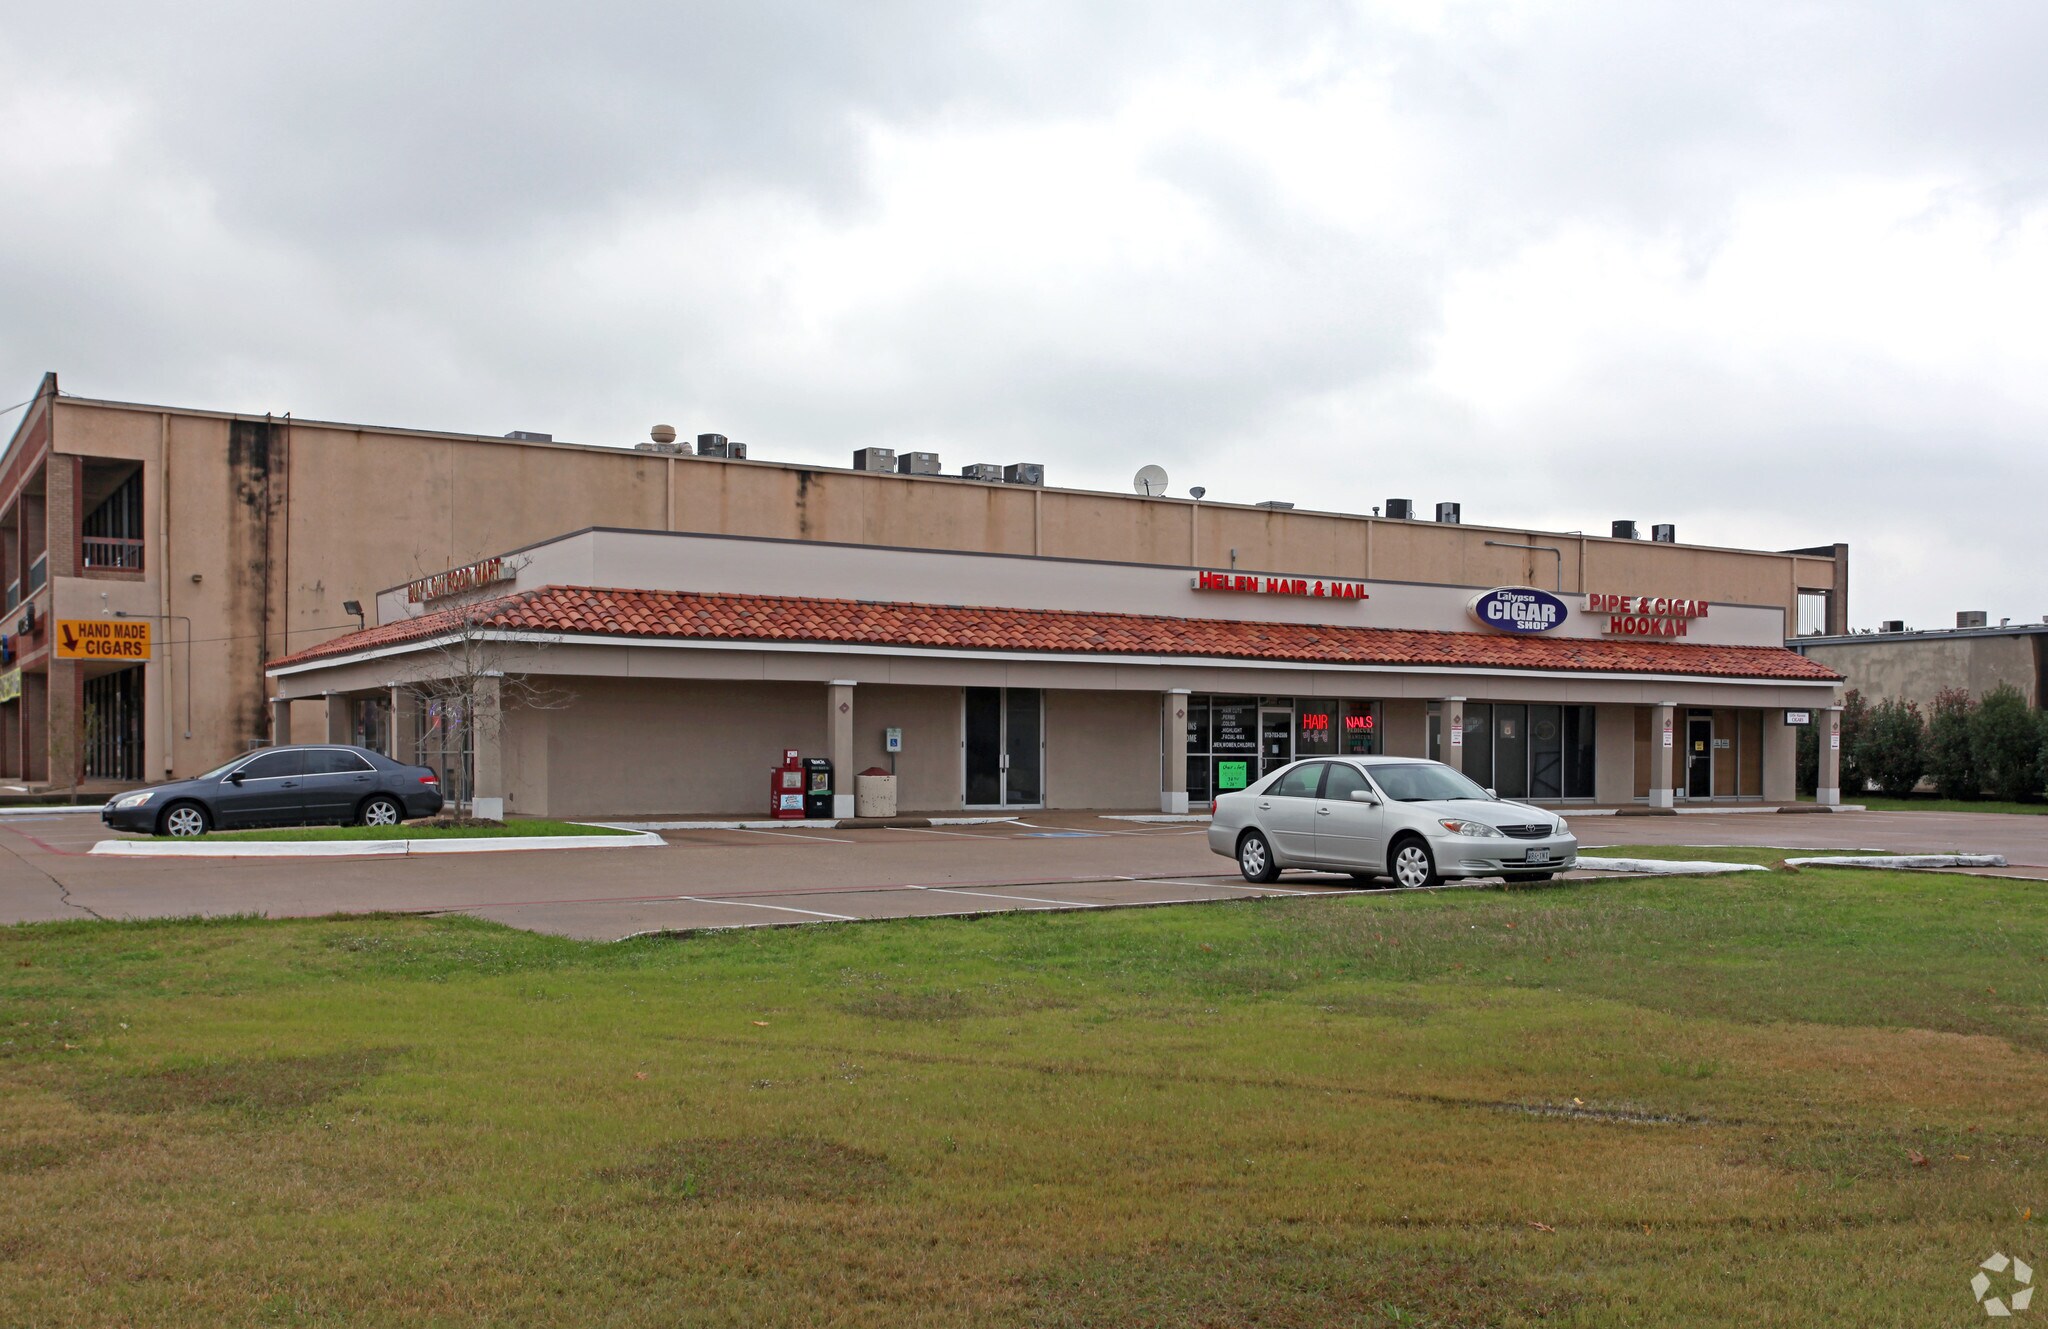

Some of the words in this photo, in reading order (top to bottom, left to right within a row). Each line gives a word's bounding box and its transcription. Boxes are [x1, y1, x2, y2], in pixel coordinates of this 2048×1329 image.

[1200, 571, 1258, 592] HELEN
[1266, 578, 1307, 596] HAIR
[1313, 581, 1325, 596] &
[1331, 582, 1369, 599] NAIL
[1497, 591, 1535, 603] Calypso
[1487, 601, 1556, 622] CIGAR
[1589, 594, 1631, 613] PIPE
[1638, 597, 1650, 614] &
[1655, 598, 1709, 617] CIGAR
[79, 624, 110, 638] HAND
[114, 625, 145, 639] MADE
[1517, 621, 1548, 630] SHOP
[1611, 616, 1687, 636] HOOKAH
[85, 640, 142, 655] CIGARS
[1303, 714, 1328, 729] HAIR
[1345, 716, 1374, 728] NAILS
